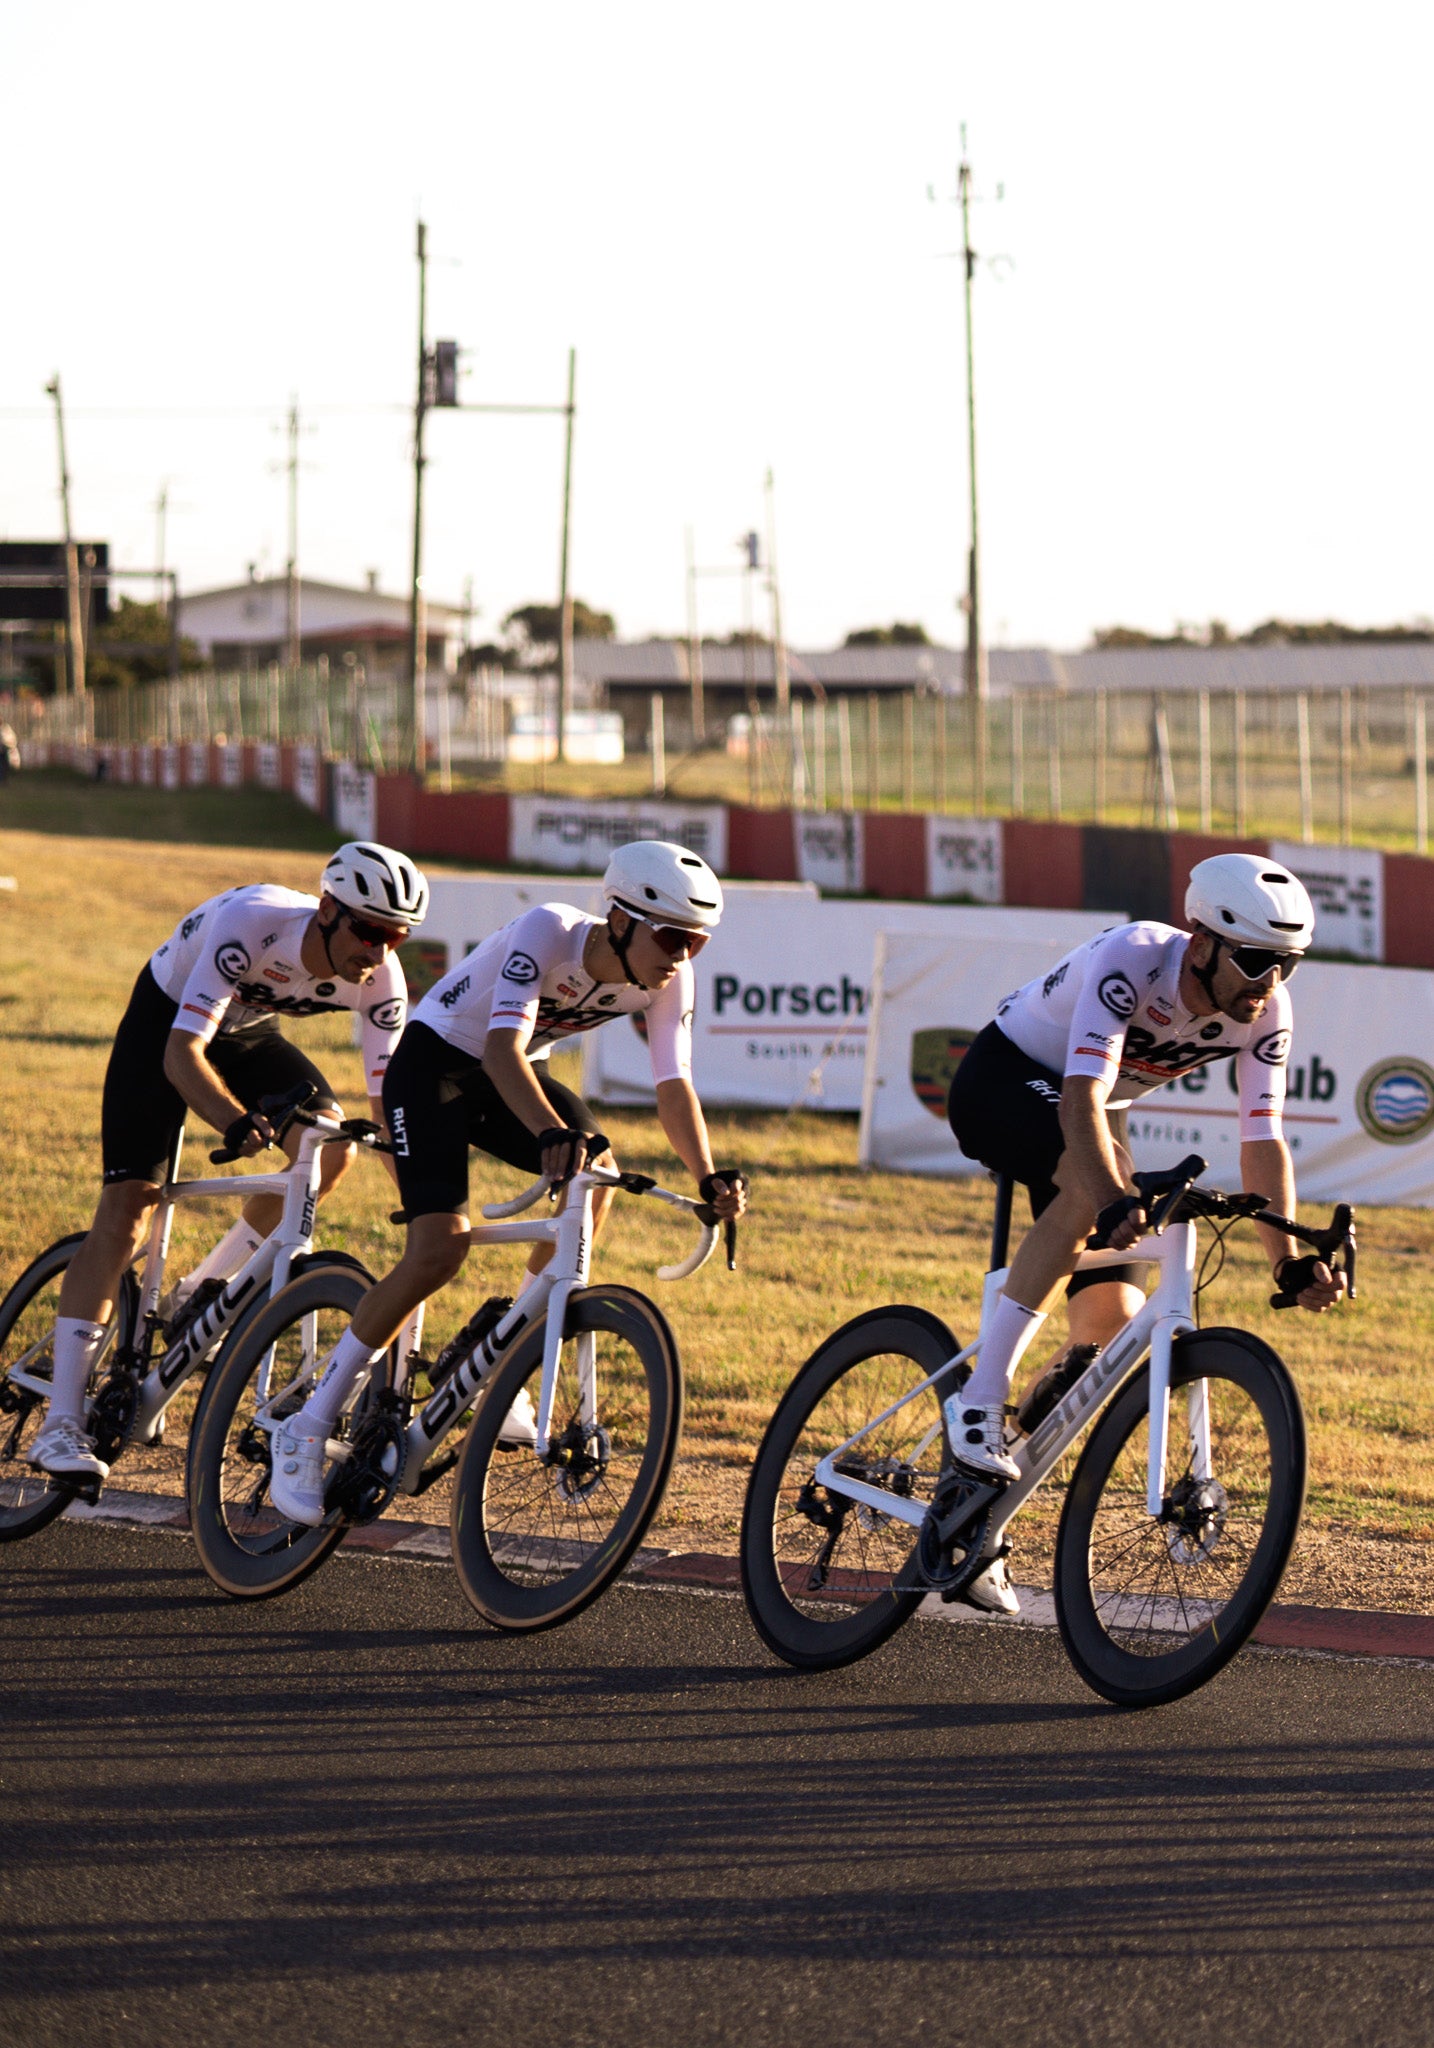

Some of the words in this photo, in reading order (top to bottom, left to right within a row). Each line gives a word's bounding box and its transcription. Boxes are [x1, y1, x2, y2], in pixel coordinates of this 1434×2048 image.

[713, 974, 871, 1016] Porsch
[746, 1042, 813, 1058] South
[822, 1042, 866, 1058] Afri
[393, 1107, 410, 1156] RH77
[420, 1312, 529, 1440] BMC
[1025, 1322, 1138, 1467] BMC
